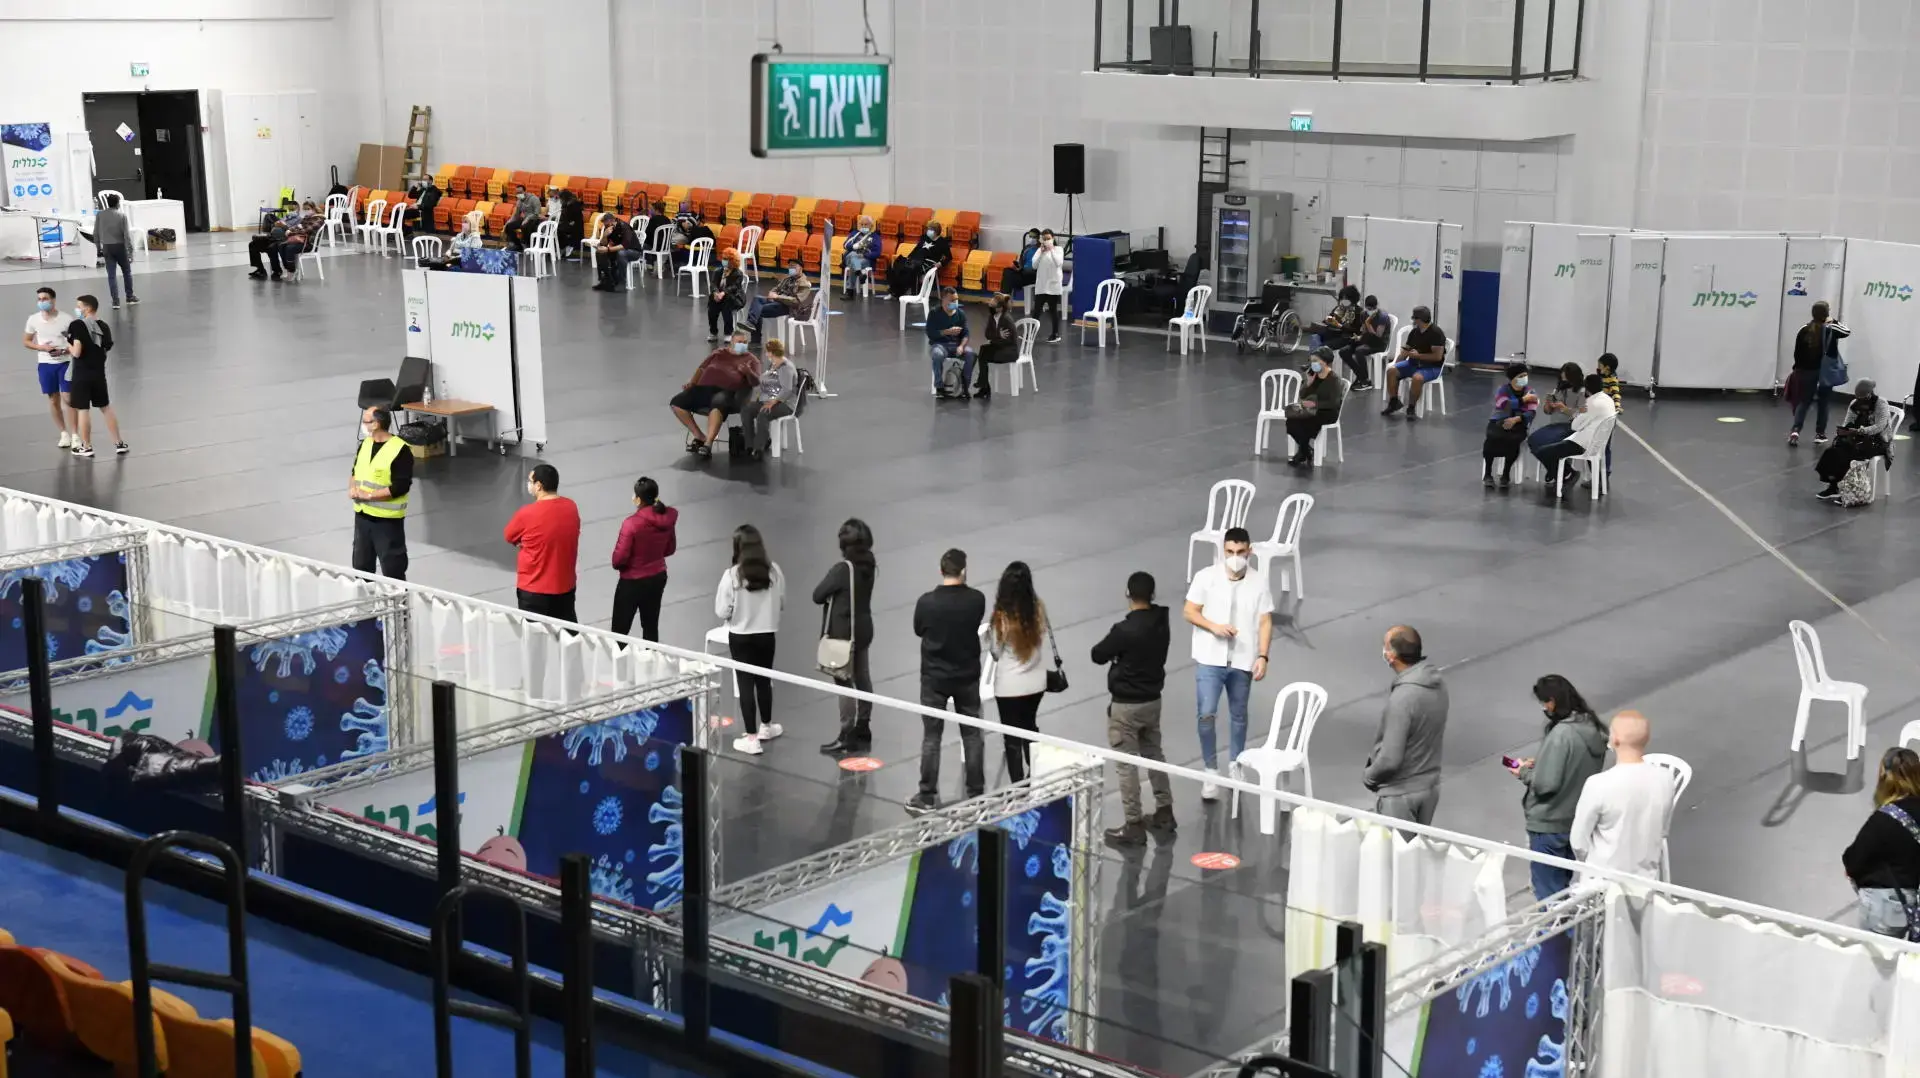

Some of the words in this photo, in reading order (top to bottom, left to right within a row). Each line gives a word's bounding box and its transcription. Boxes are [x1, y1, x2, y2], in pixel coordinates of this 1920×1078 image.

[809, 74, 881, 138] יציאה
[12, 157, 37, 168] כללית
[1383, 257, 1409, 272] כללית
[1554, 263, 1576, 278] לית
[1863, 280, 1898, 299] כללית
[1693, 291, 1737, 307] כללית
[412, 316, 417, 324] 2
[451, 320, 481, 339] כללית
